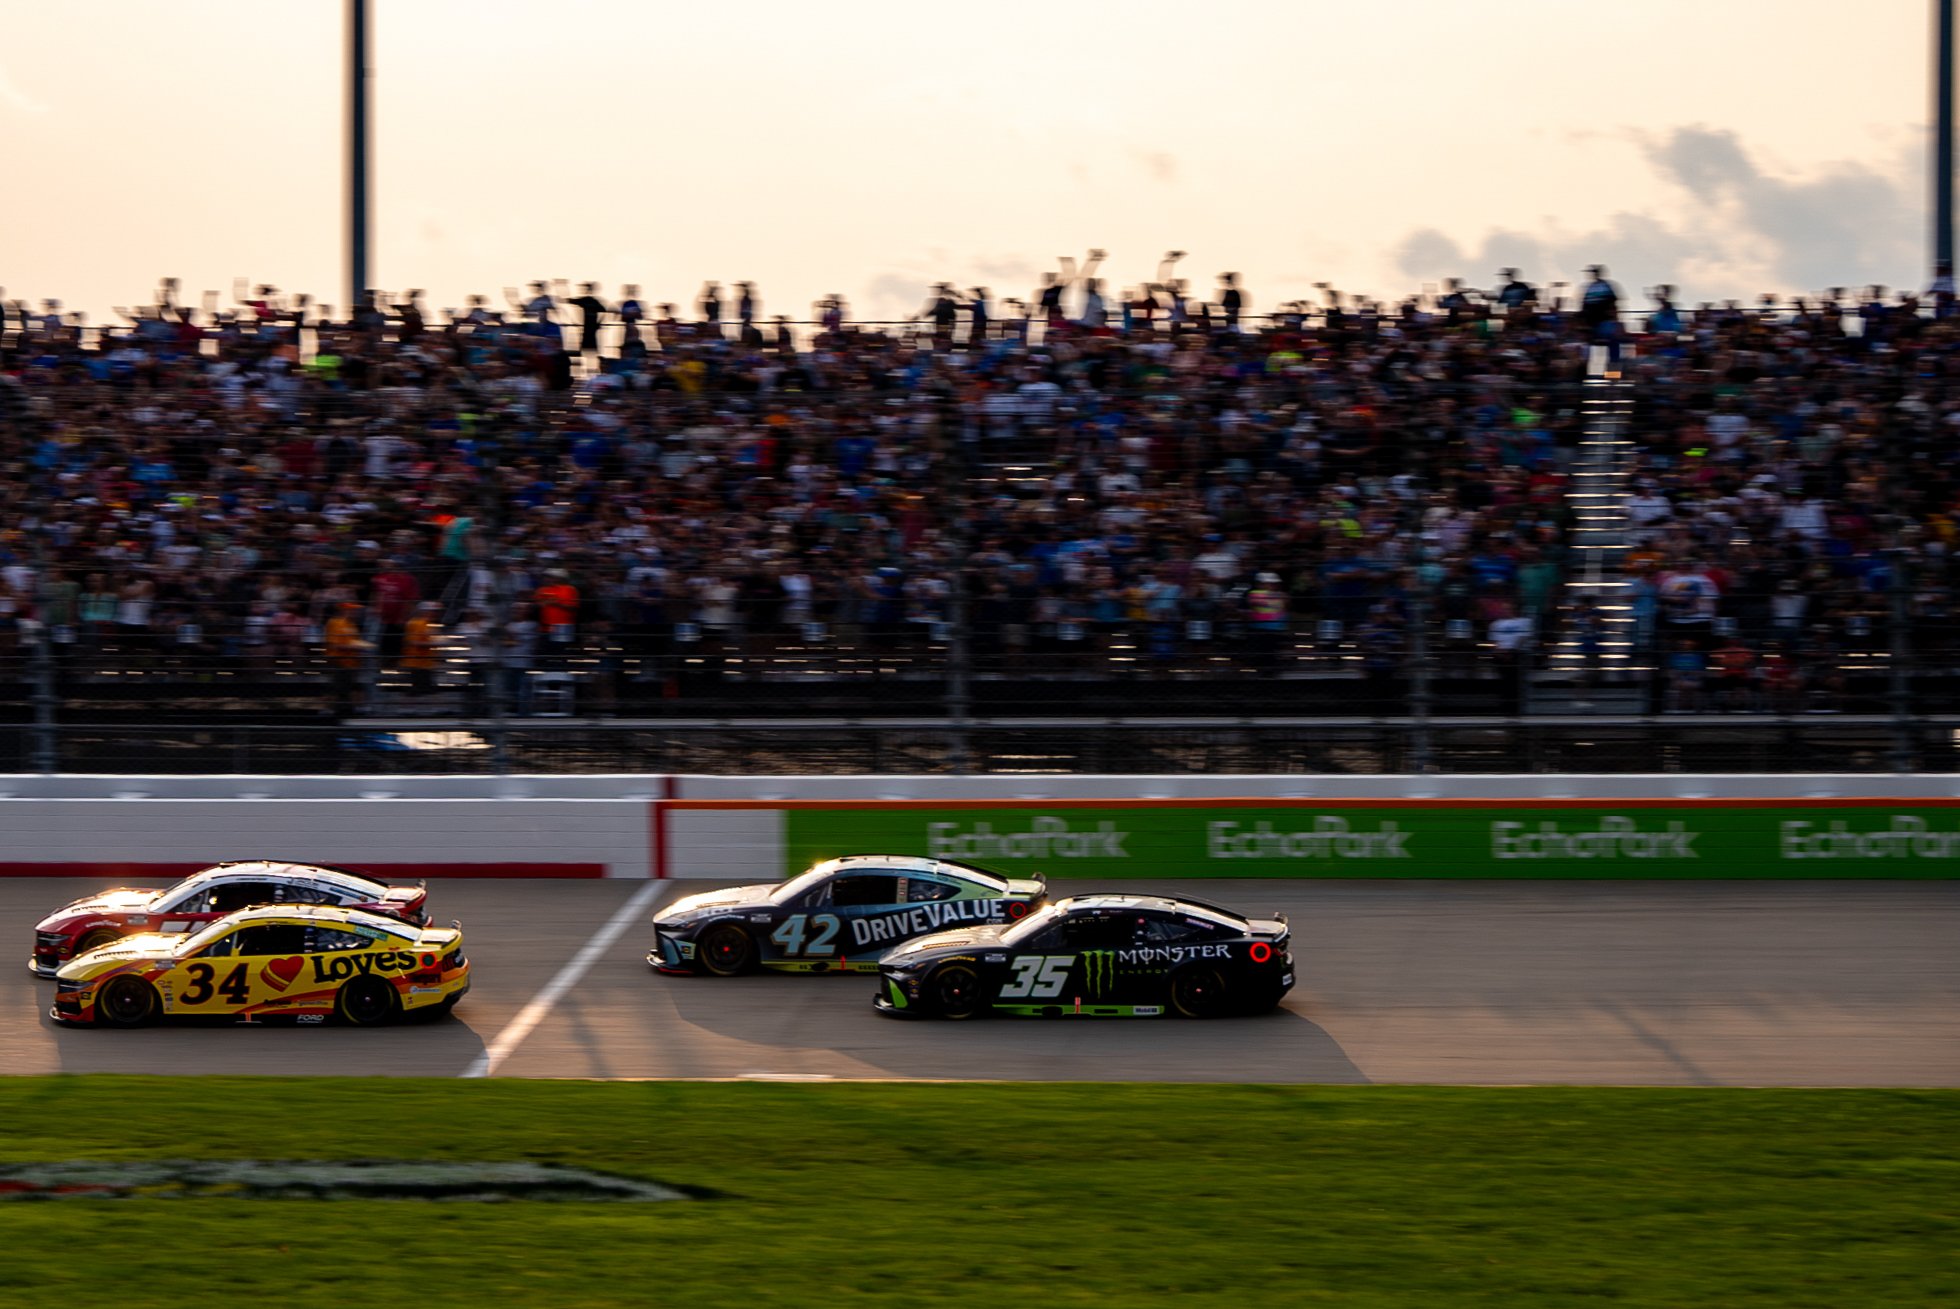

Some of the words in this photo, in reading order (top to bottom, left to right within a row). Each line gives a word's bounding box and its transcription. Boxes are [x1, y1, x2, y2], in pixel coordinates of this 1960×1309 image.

[927, 816, 1132, 858] EchoPark
[1207, 815, 1414, 858] EchoPark
[1491, 815, 1699, 858] EchoPark
[1780, 815, 1960, 858] EchoPar
[771, 914, 841, 956] 42
[1118, 944, 1232, 965] MONSTER
[179, 962, 250, 1006] 34
[999, 955, 1077, 998] 35
